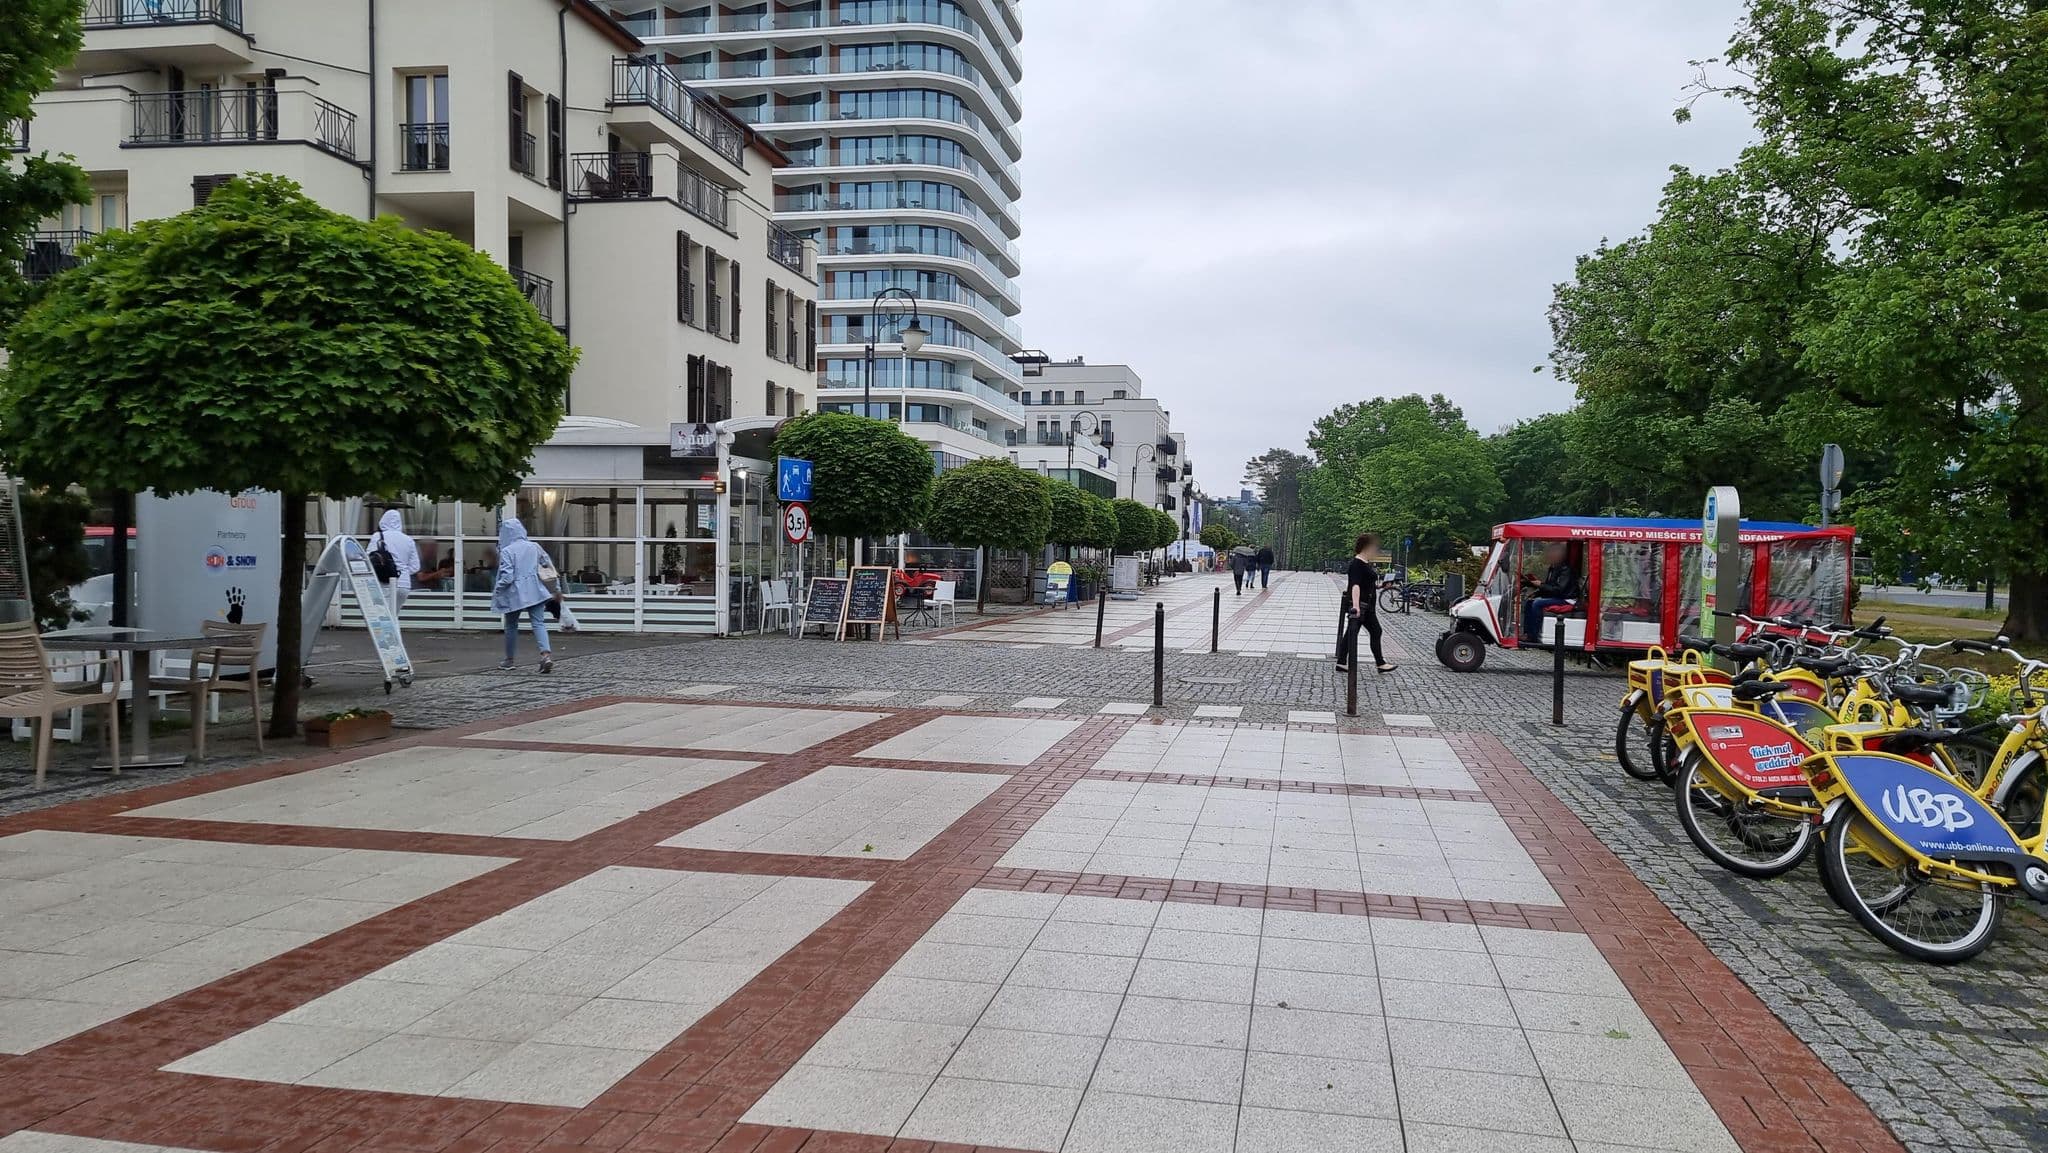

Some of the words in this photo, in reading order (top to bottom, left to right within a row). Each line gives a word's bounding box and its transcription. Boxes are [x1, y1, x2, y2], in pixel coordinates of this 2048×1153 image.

[217, 530, 246, 541] Partnerzy
[1571, 529, 1627, 538] WYCIECZKI
[1629, 530, 1643, 538] PO
[1645, 530, 1687, 540] MIEŚCIE
[226, 555, 234, 566] &
[235, 555, 257, 567] SNOW
[1882, 783, 1975, 833] UBB
[1919, 839, 2016, 854] www.ubb-online.com
